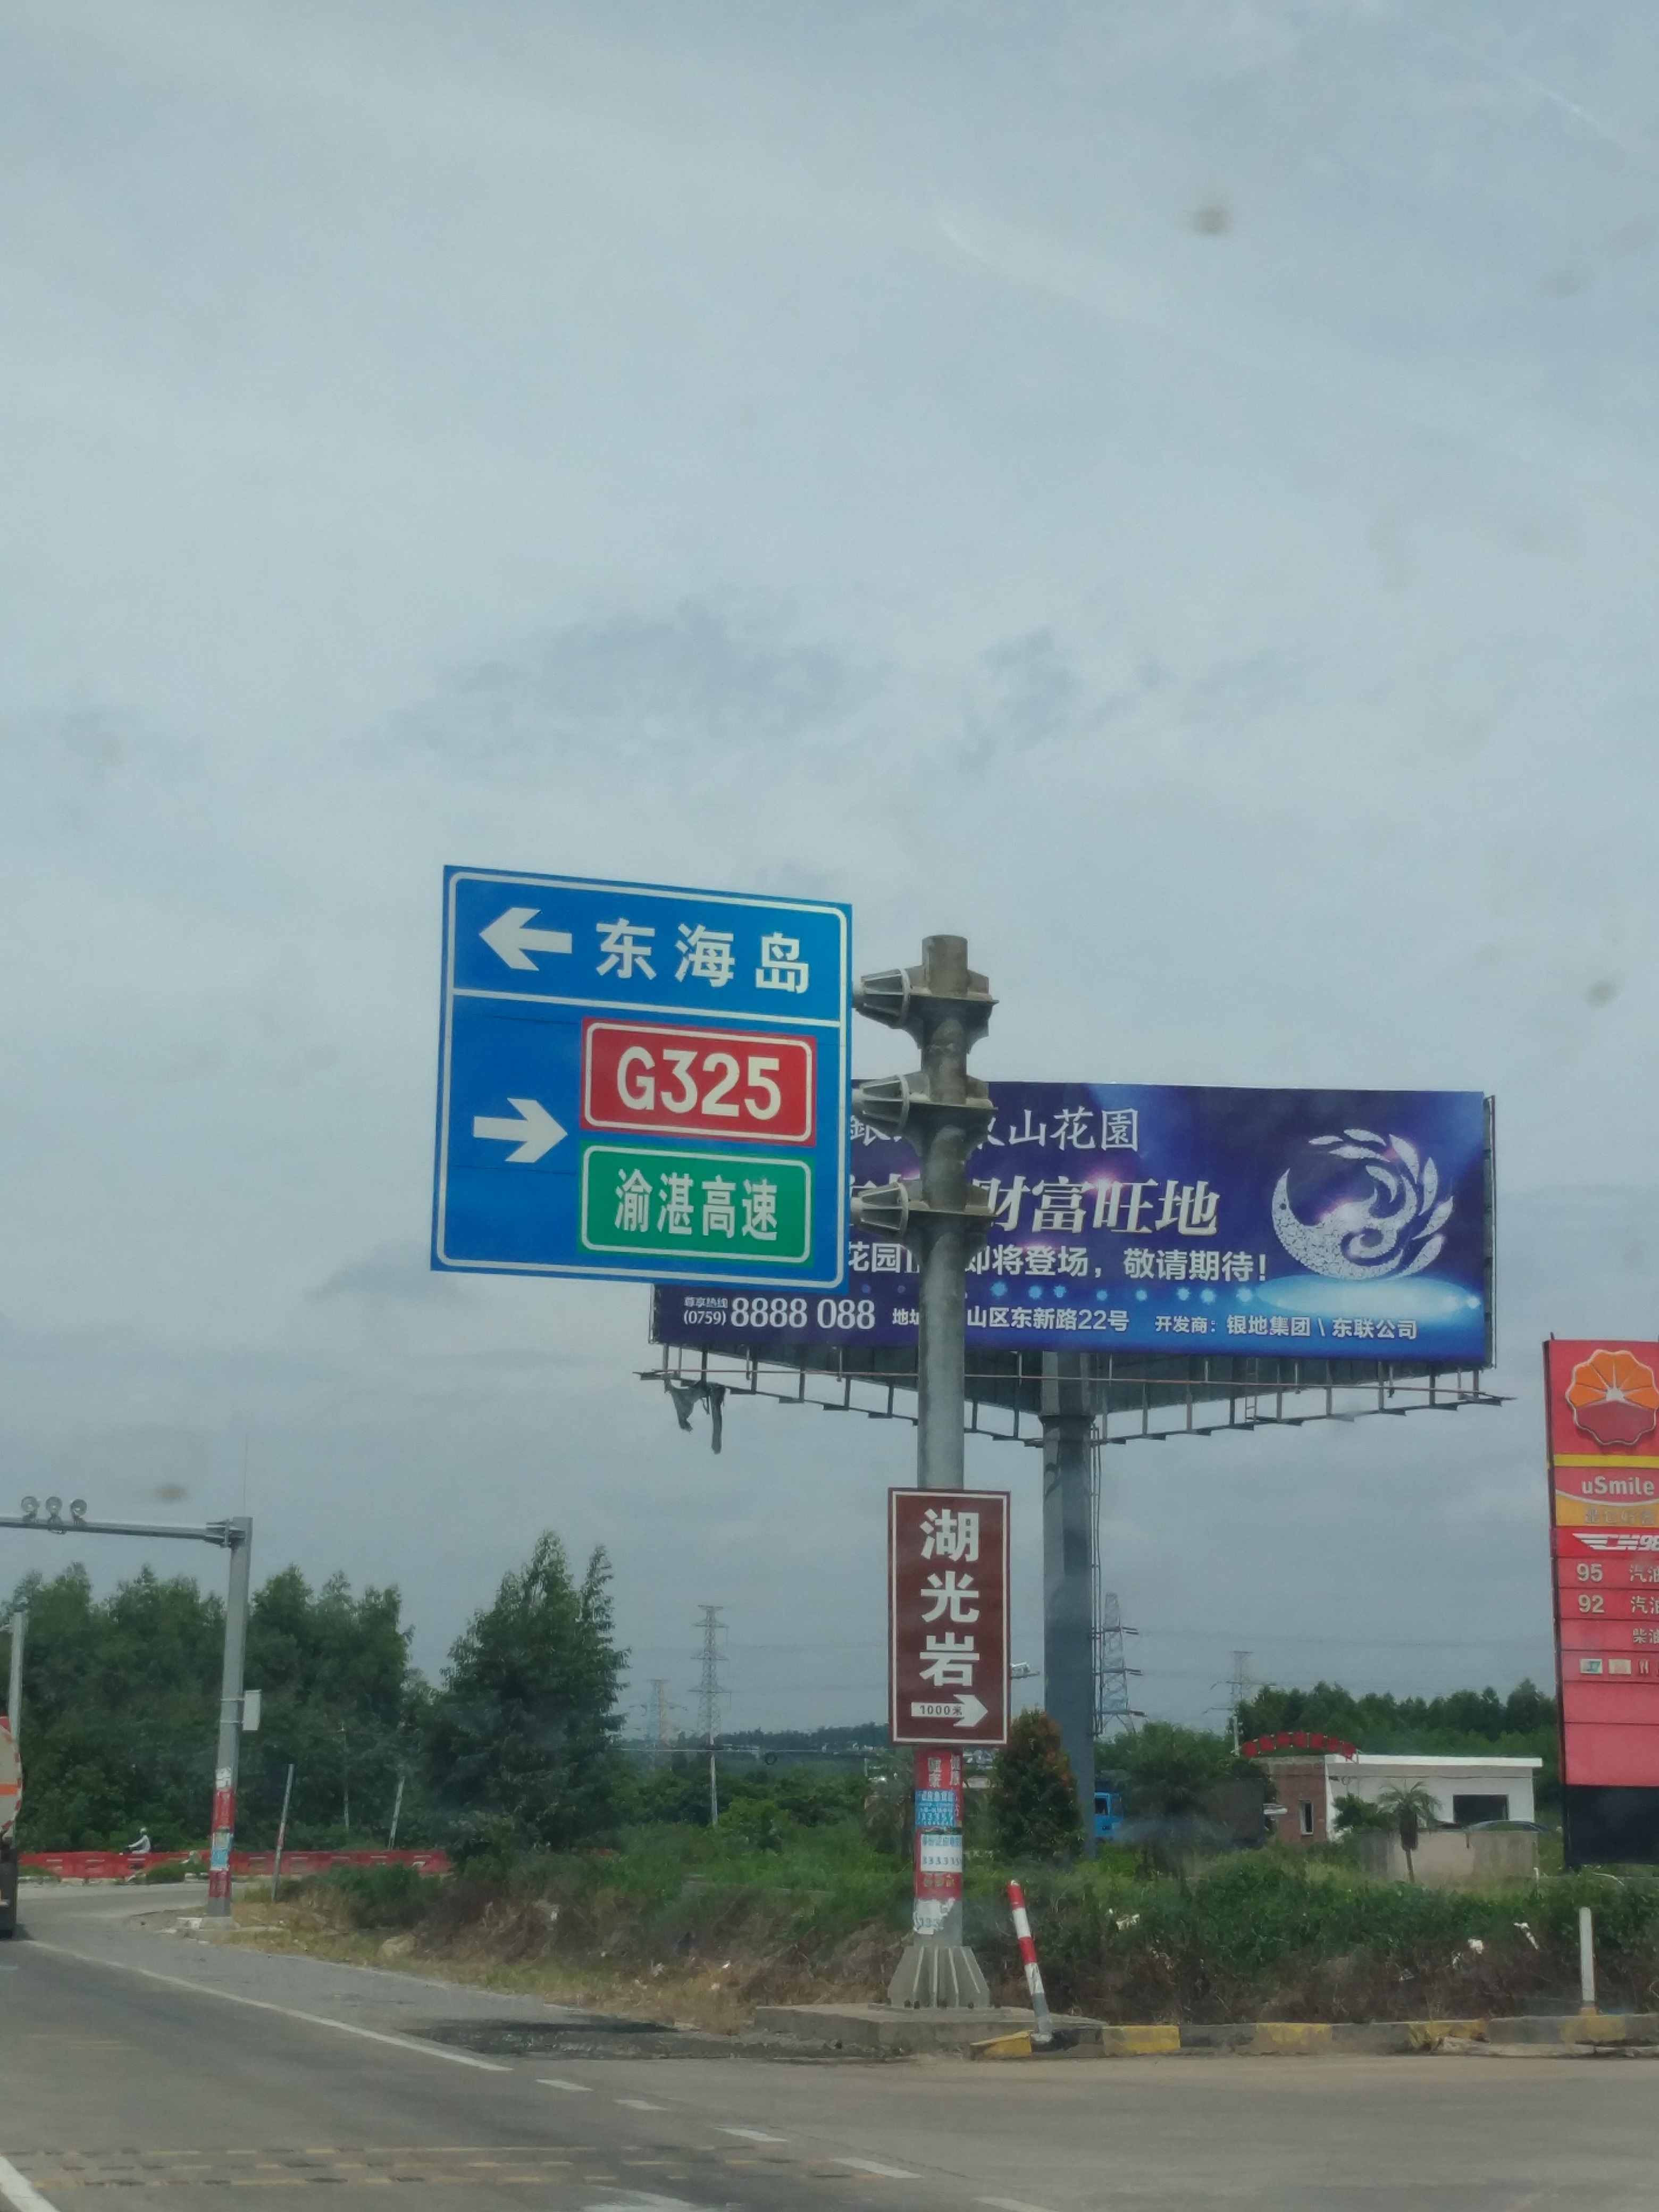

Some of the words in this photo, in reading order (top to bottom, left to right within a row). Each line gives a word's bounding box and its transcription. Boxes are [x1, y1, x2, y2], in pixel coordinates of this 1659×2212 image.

[596, 918, 810, 994] 东海岛
[616, 1046, 782, 1120] G325
[614, 1169, 778, 1241] 渝湛高速
[850, 1175, 1220, 1236] 财富旺地
[684, 1310, 726, 1326] (0759)
[731, 1297, 808, 1328] 8888
[817, 1299, 876, 1330] 088
[967, 1306, 1129, 1332] 山区东新路22号
[1581, 1476, 1655, 1496] uSmile
[1577, 1563, 1603, 1582] 95
[919, 1508, 980, 1687] 湖光岩
[1578, 1594, 1605, 1613] 92
[919, 1705, 962, 1716] 1000米
